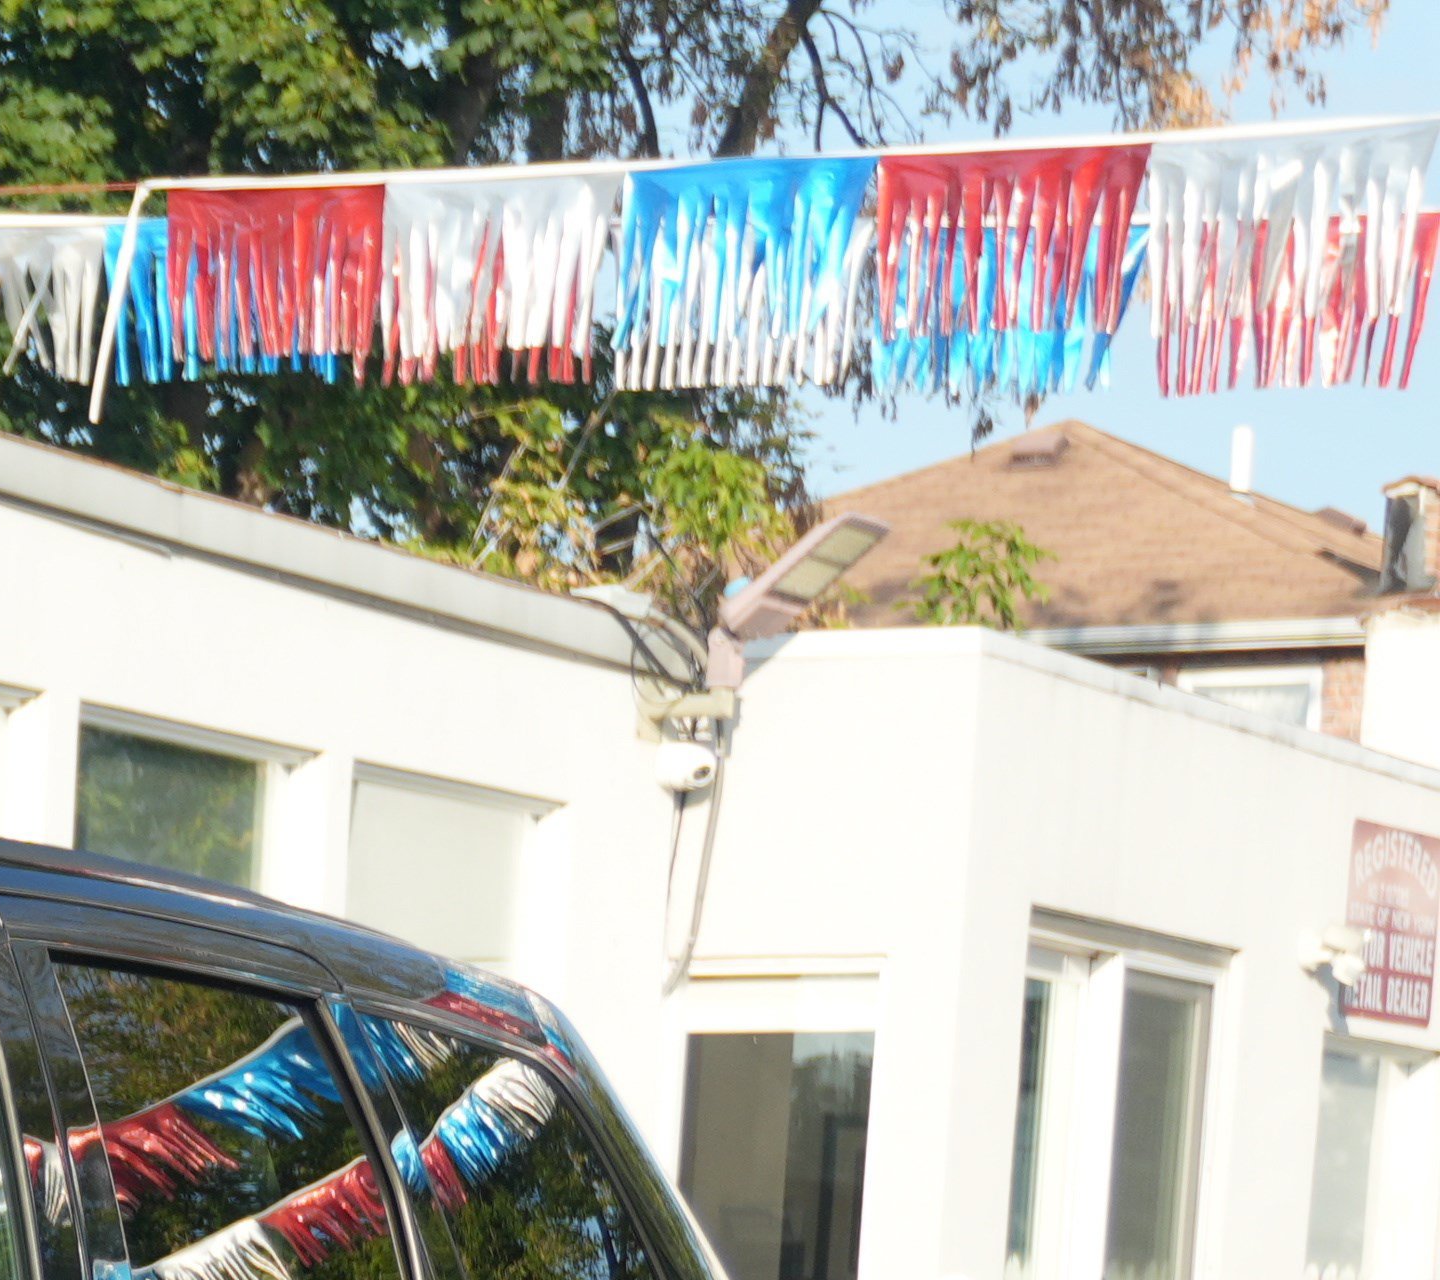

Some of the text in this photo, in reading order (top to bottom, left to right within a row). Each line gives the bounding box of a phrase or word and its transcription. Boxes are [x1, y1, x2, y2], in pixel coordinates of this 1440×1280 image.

[1354, 829, 1439, 898] REGISTERED
[1389, 932, 1434, 976] VEHICLE
[1386, 978, 1429, 1018] DEALER
